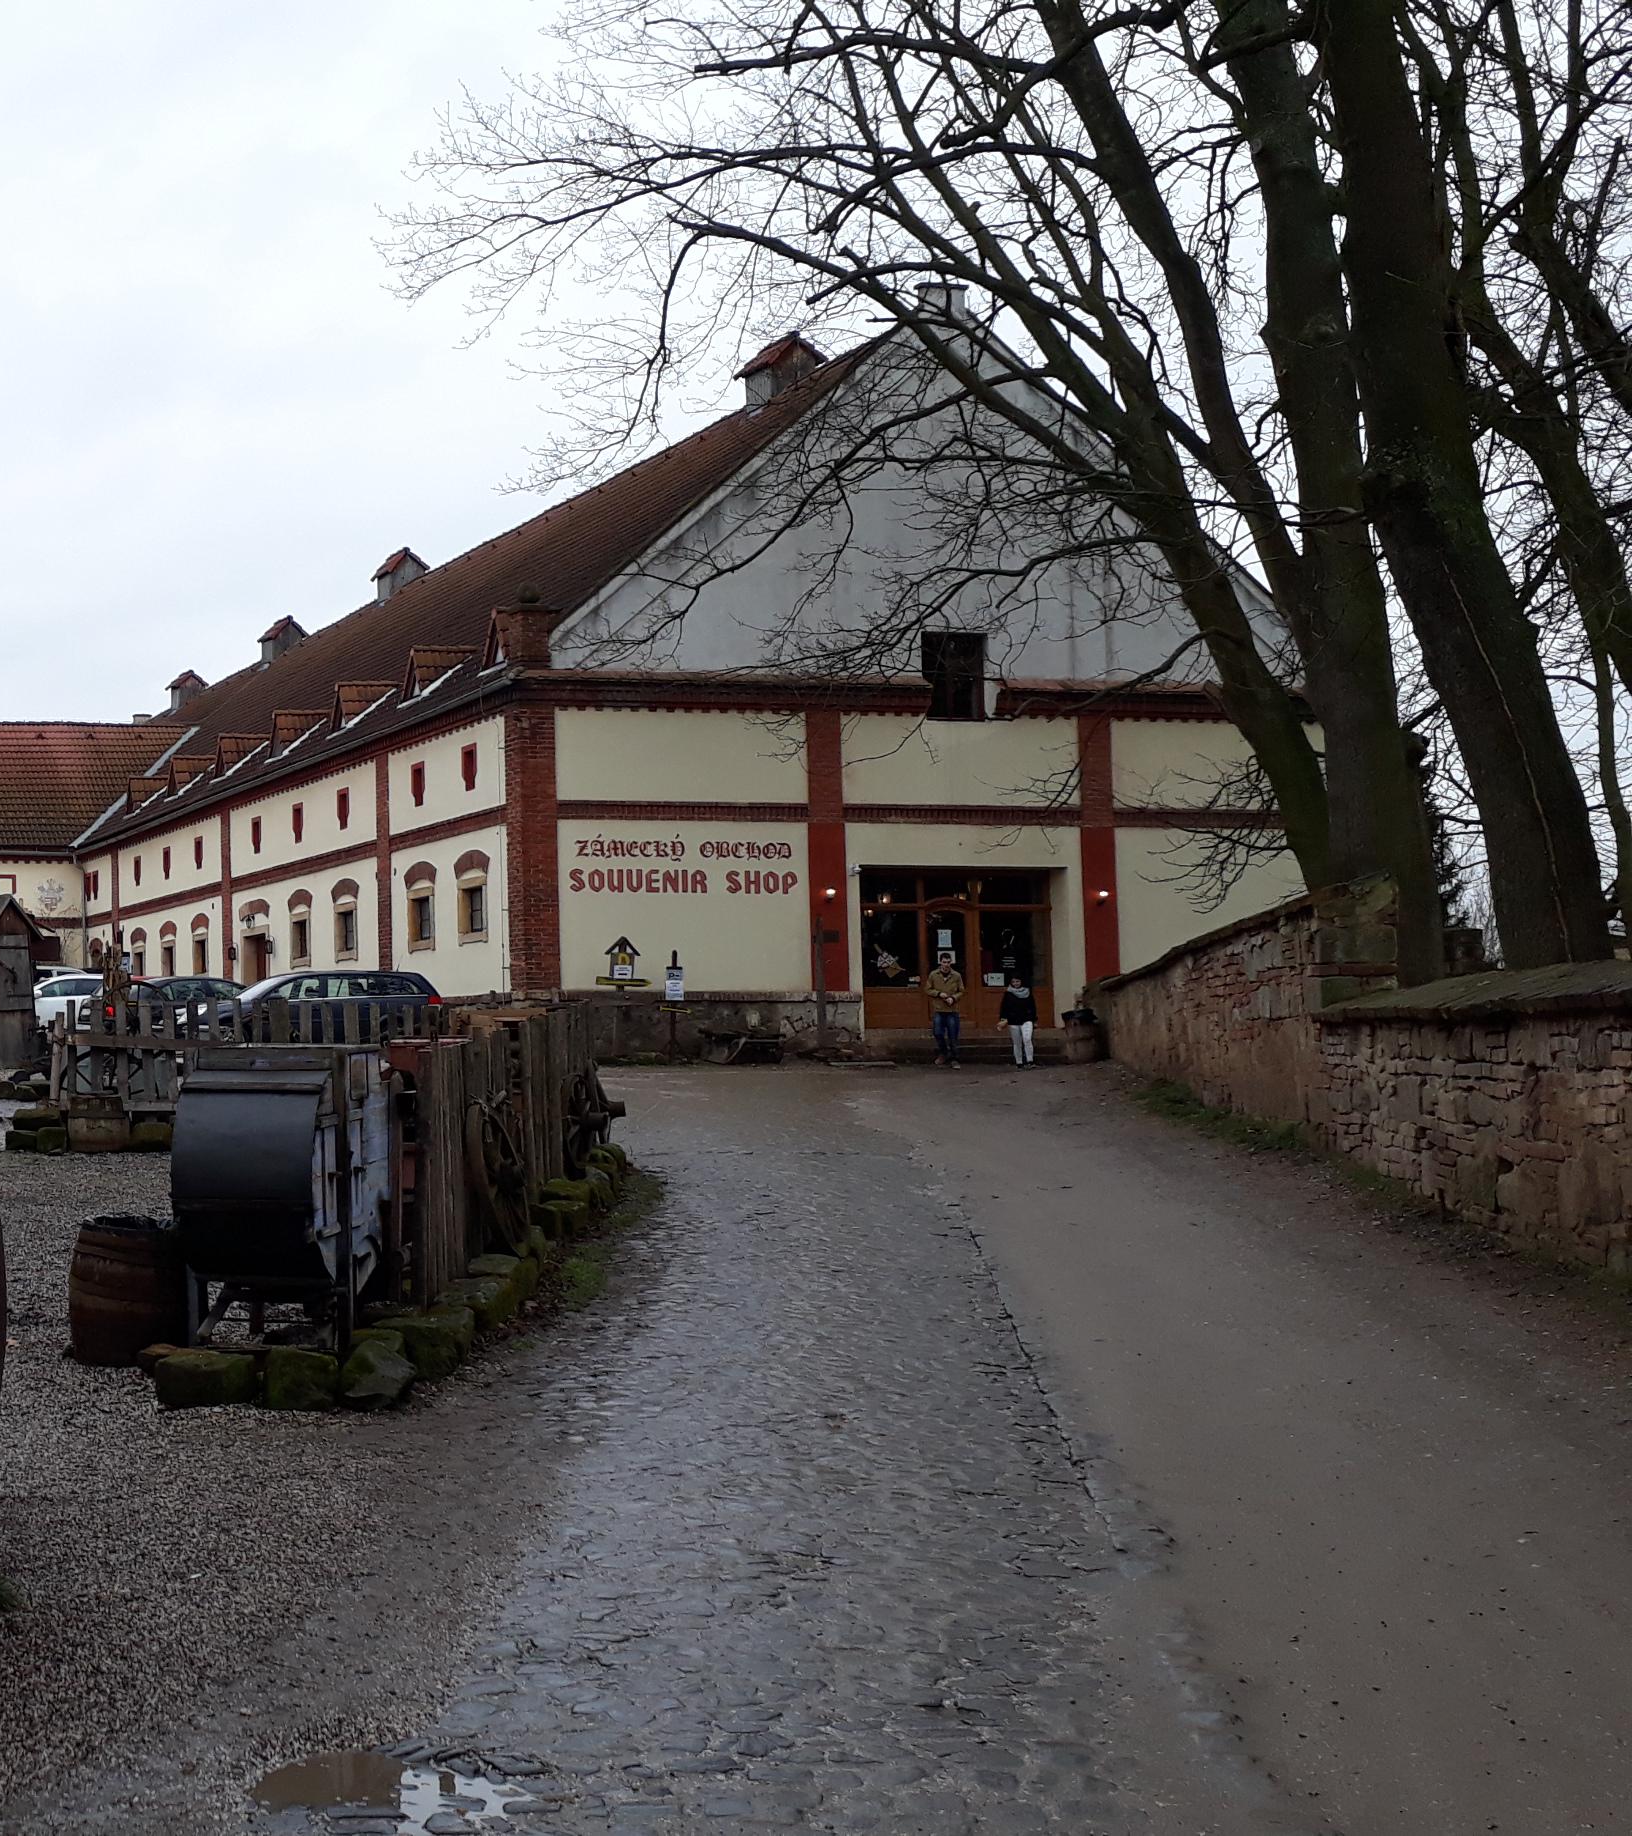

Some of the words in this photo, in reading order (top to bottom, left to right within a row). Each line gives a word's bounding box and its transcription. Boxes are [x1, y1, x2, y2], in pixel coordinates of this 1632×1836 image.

[574, 833, 685, 862] ZÁMECKÝ
[699, 840, 793, 861] OBCHOD
[568, 868, 708, 894] SOUVENIR
[725, 869, 799, 895] SHOP
